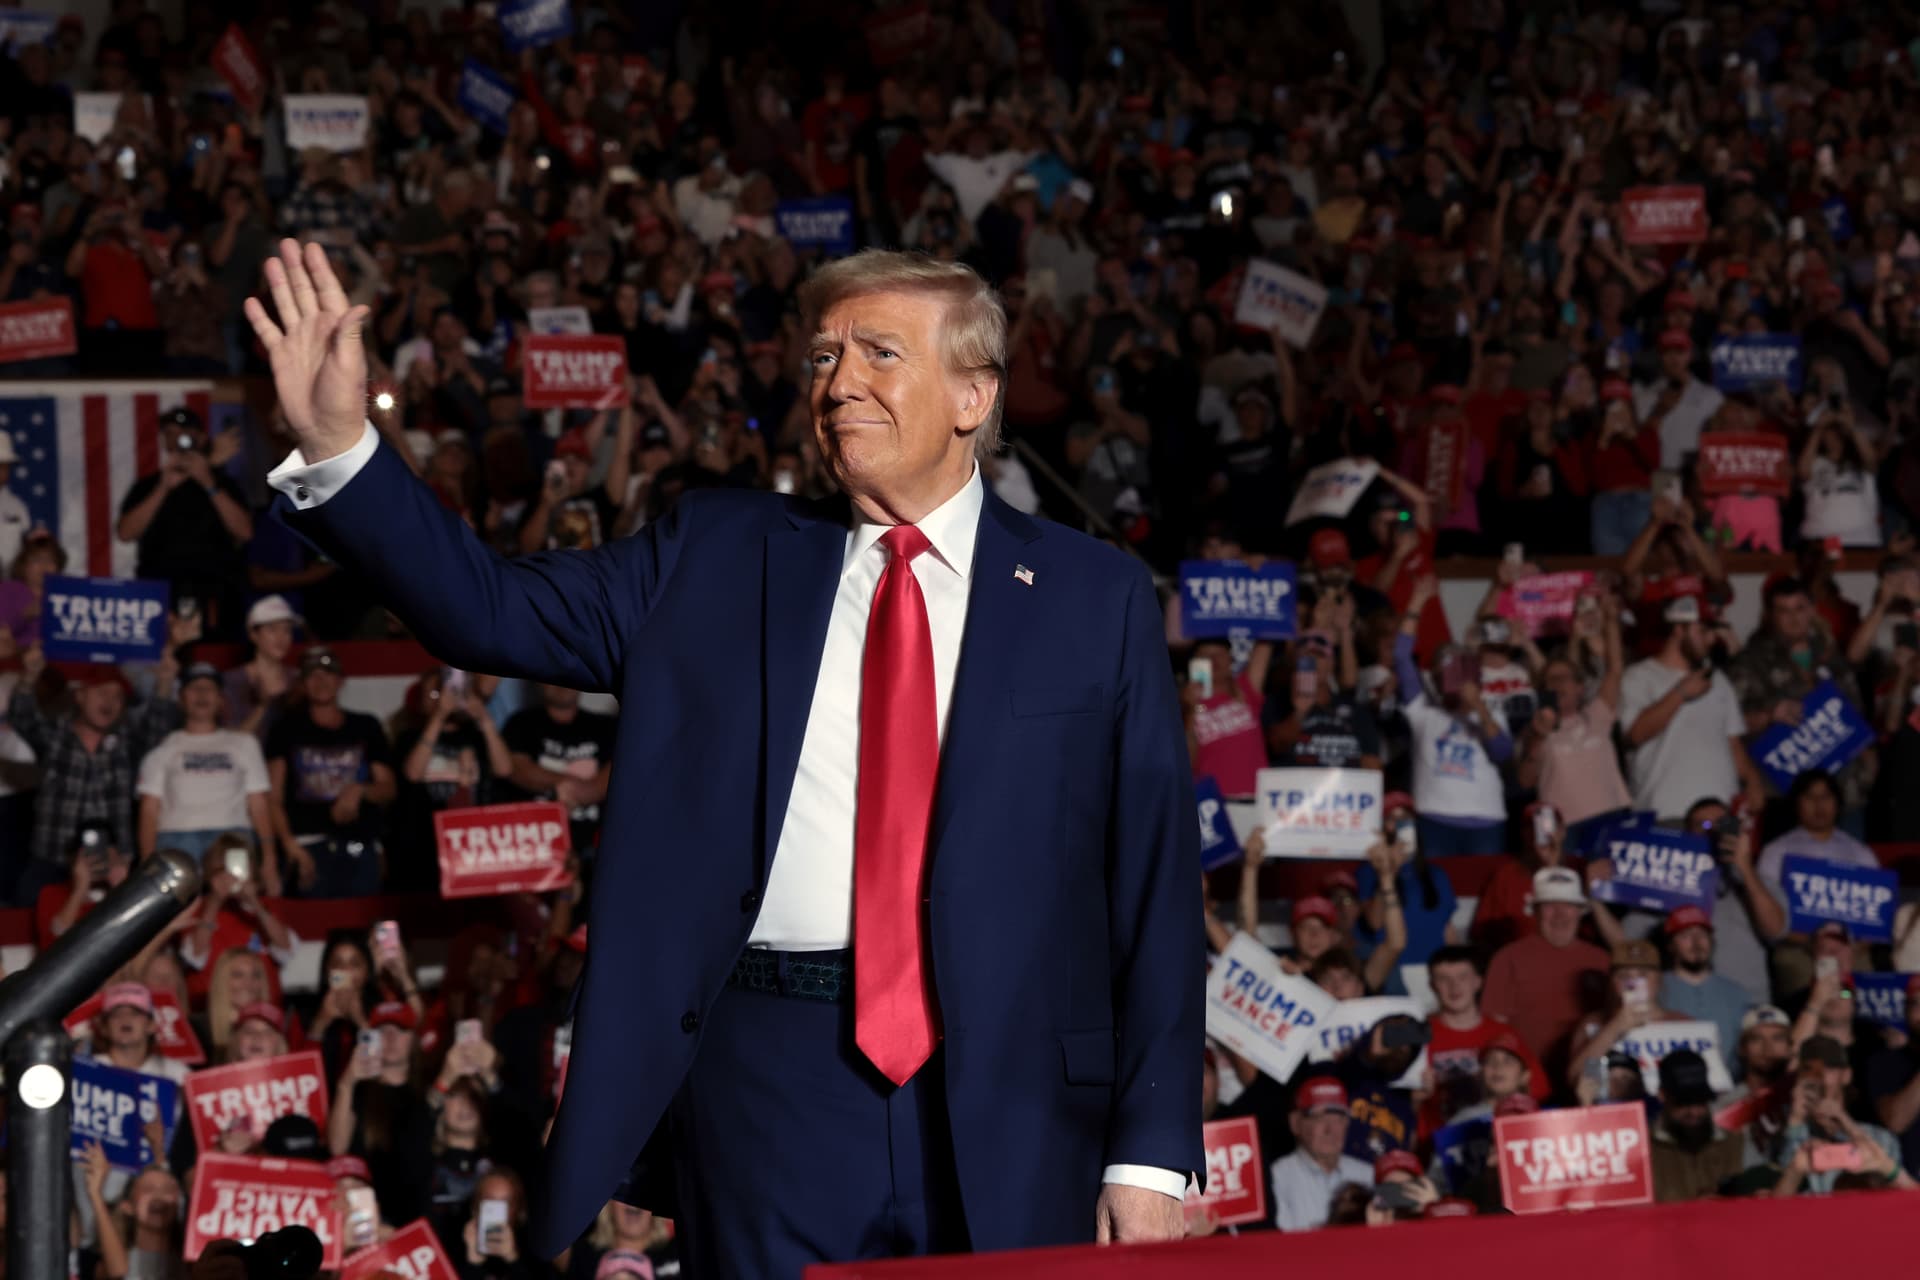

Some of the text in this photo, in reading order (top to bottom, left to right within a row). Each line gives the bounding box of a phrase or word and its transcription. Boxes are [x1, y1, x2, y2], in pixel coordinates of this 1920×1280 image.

[529, 350, 623, 371] TRUMP
[540, 367, 611, 386] VANCE
[1706, 446, 1785, 465] TRUMP
[1716, 461, 1776, 478] VANCE
[1185, 577, 1292, 599] TRUMP
[48, 593, 163, 621] TRUMP
[1198, 596, 1279, 615] VANCE
[60, 616, 149, 639] VANCE
[1763, 697, 1844, 771] TRUMP
[1782, 721, 1849, 776] VANCE
[445, 821, 563, 852] TRUMP
[460, 842, 552, 868] VANCE
[1608, 841, 1715, 872] TRUMP
[1616, 860, 1698, 889] VANCE
[1788, 872, 1893, 905] TRUMP
[1801, 892, 1879, 919] VANCE
[1223, 958, 1316, 1028] TRUMP
[1219, 985, 1293, 1042] VANCE
[1623, 1039, 1713, 1057] RUMP
[72, 1077, 137, 1116] UMP
[196, 1073, 319, 1119] TRUMP
[73, 1104, 124, 1138] NCE
[213, 1097, 311, 1131] VNCE
[1506, 1127, 1640, 1168] TRUMP
[1524, 1153, 1629, 1185] VANCE
[212, 1187, 321, 1220] VANCE
[197, 1209, 334, 1245] TUMP
